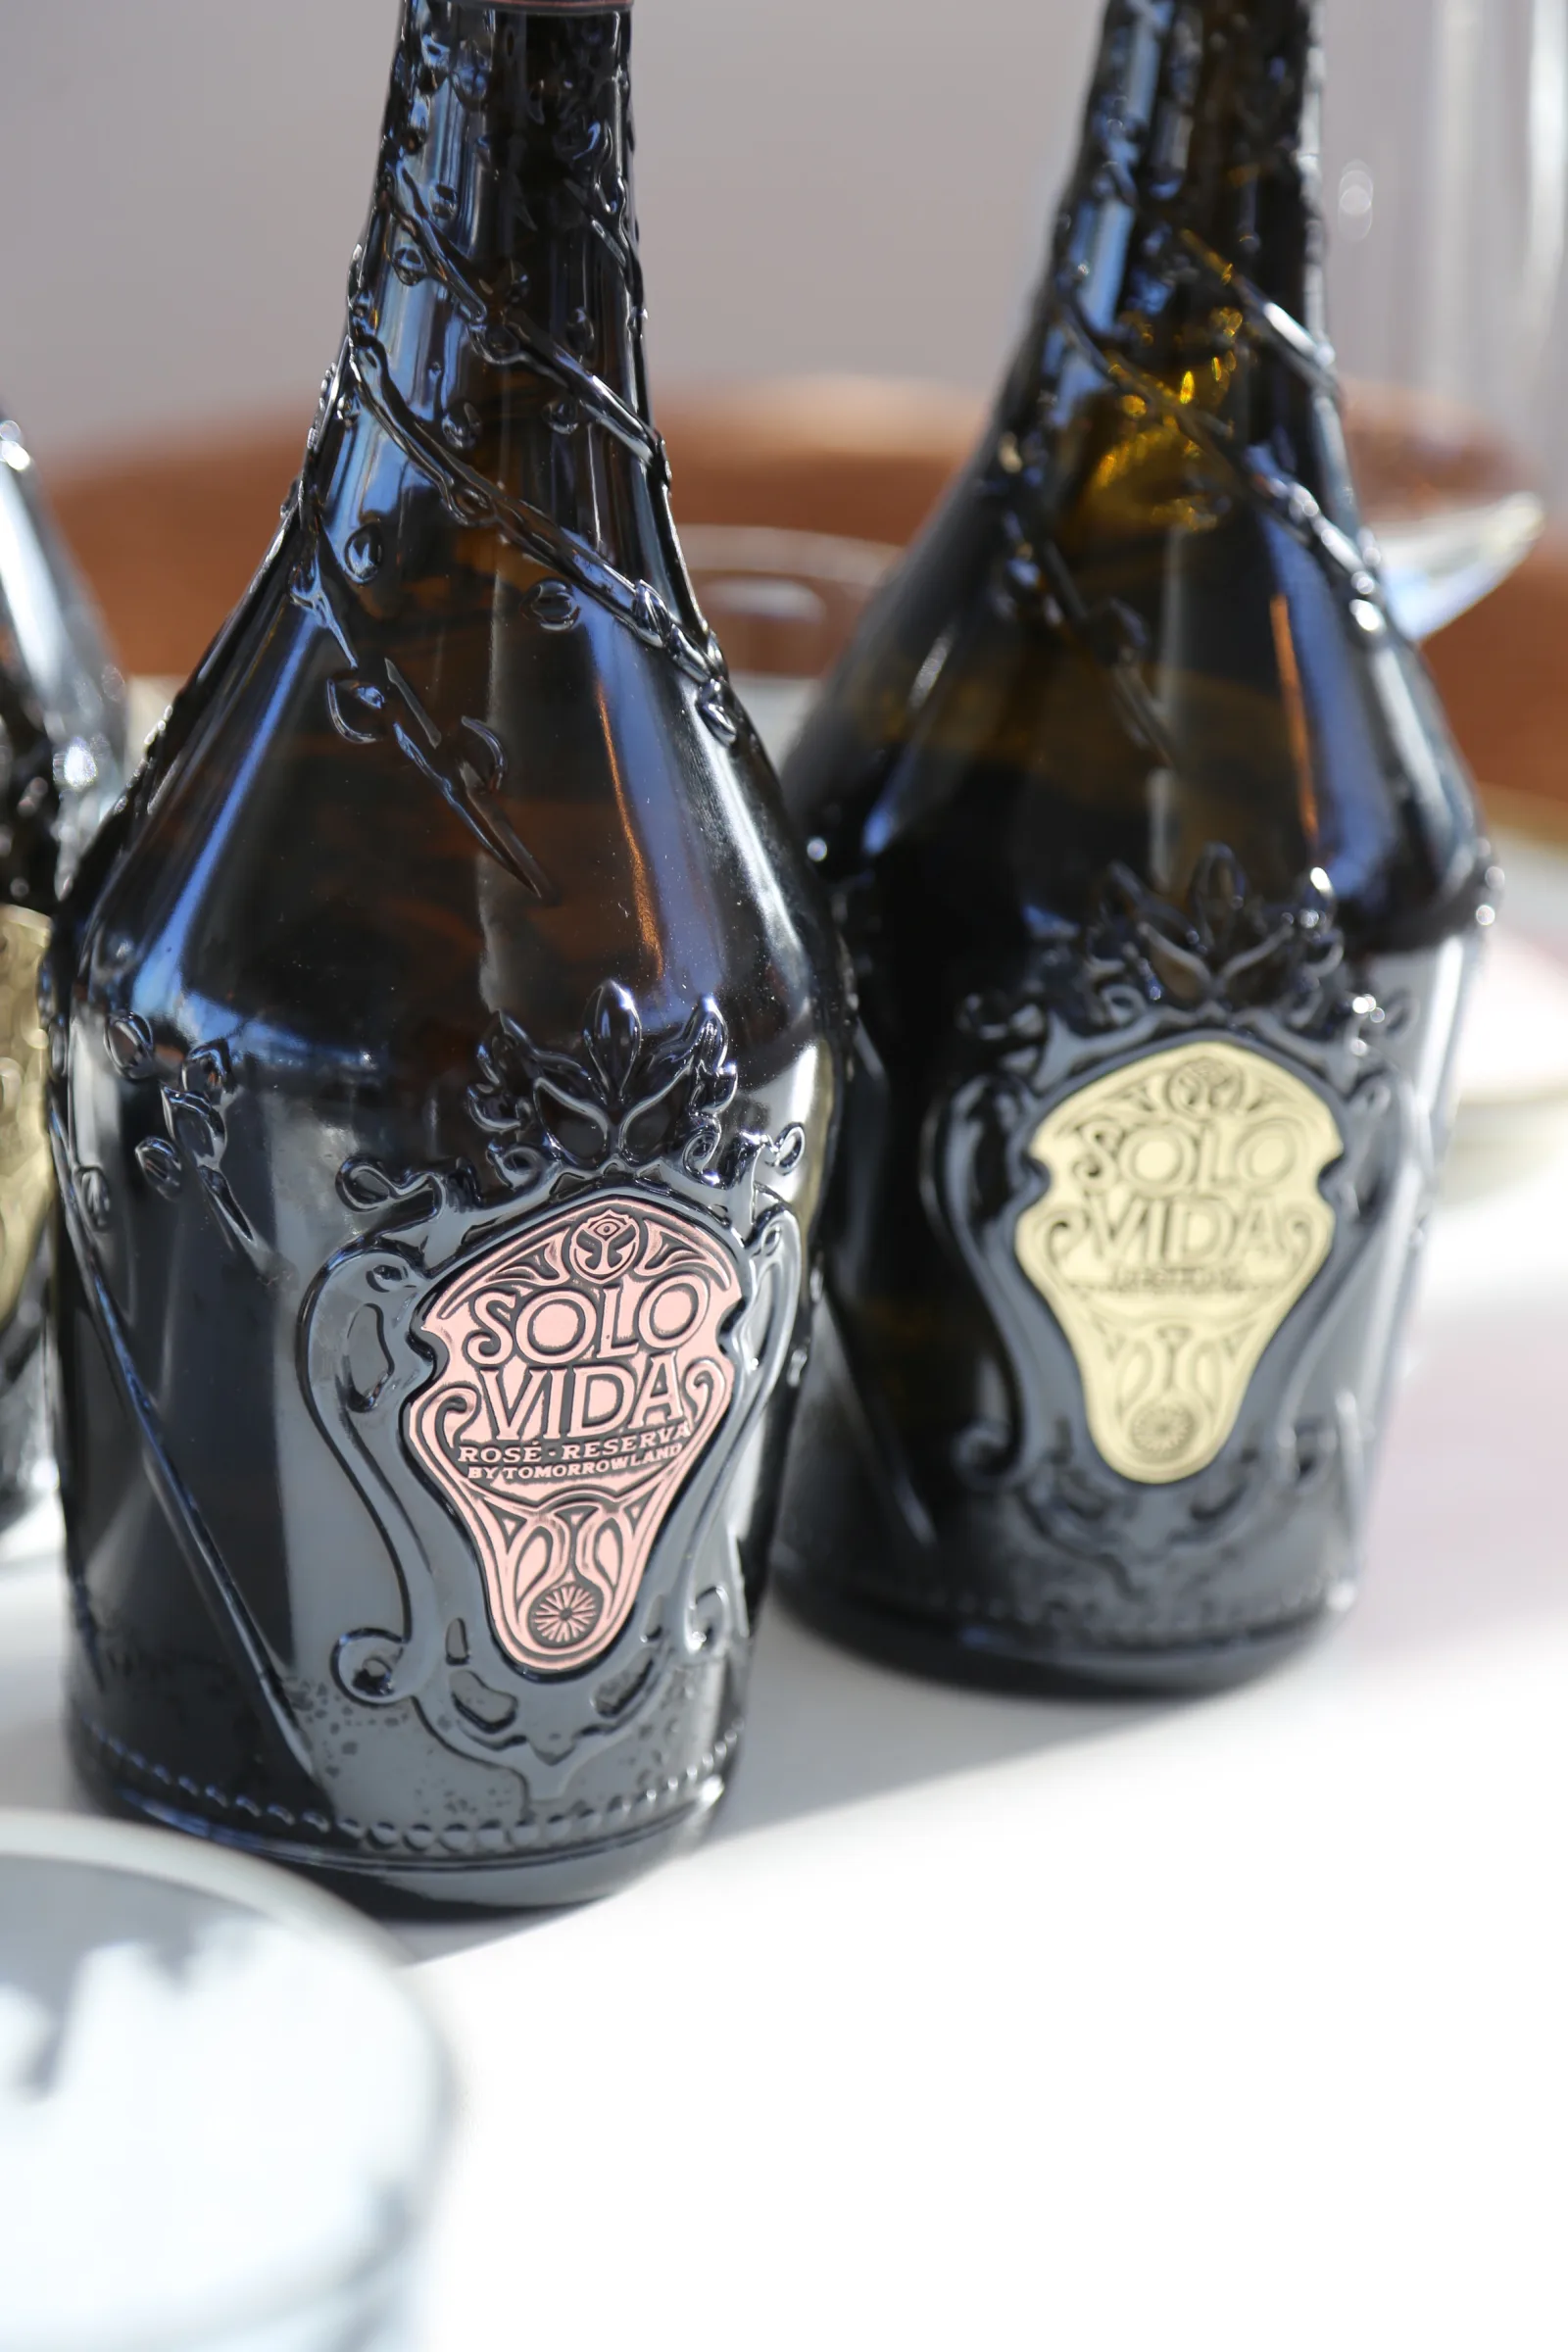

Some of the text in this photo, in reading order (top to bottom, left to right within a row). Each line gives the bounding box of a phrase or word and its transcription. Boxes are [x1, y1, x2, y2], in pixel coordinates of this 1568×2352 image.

[1073, 1119, 1298, 1196] SOLO
[1085, 1192, 1282, 1266] VIDA
[466, 1273, 710, 1366] SOLO
[479, 1349, 684, 1442] VIDA
[458, 1420, 691, 1463] ROSÉ RESERVA
[467, 1443, 684, 1480] BY TOMORROWLAND
